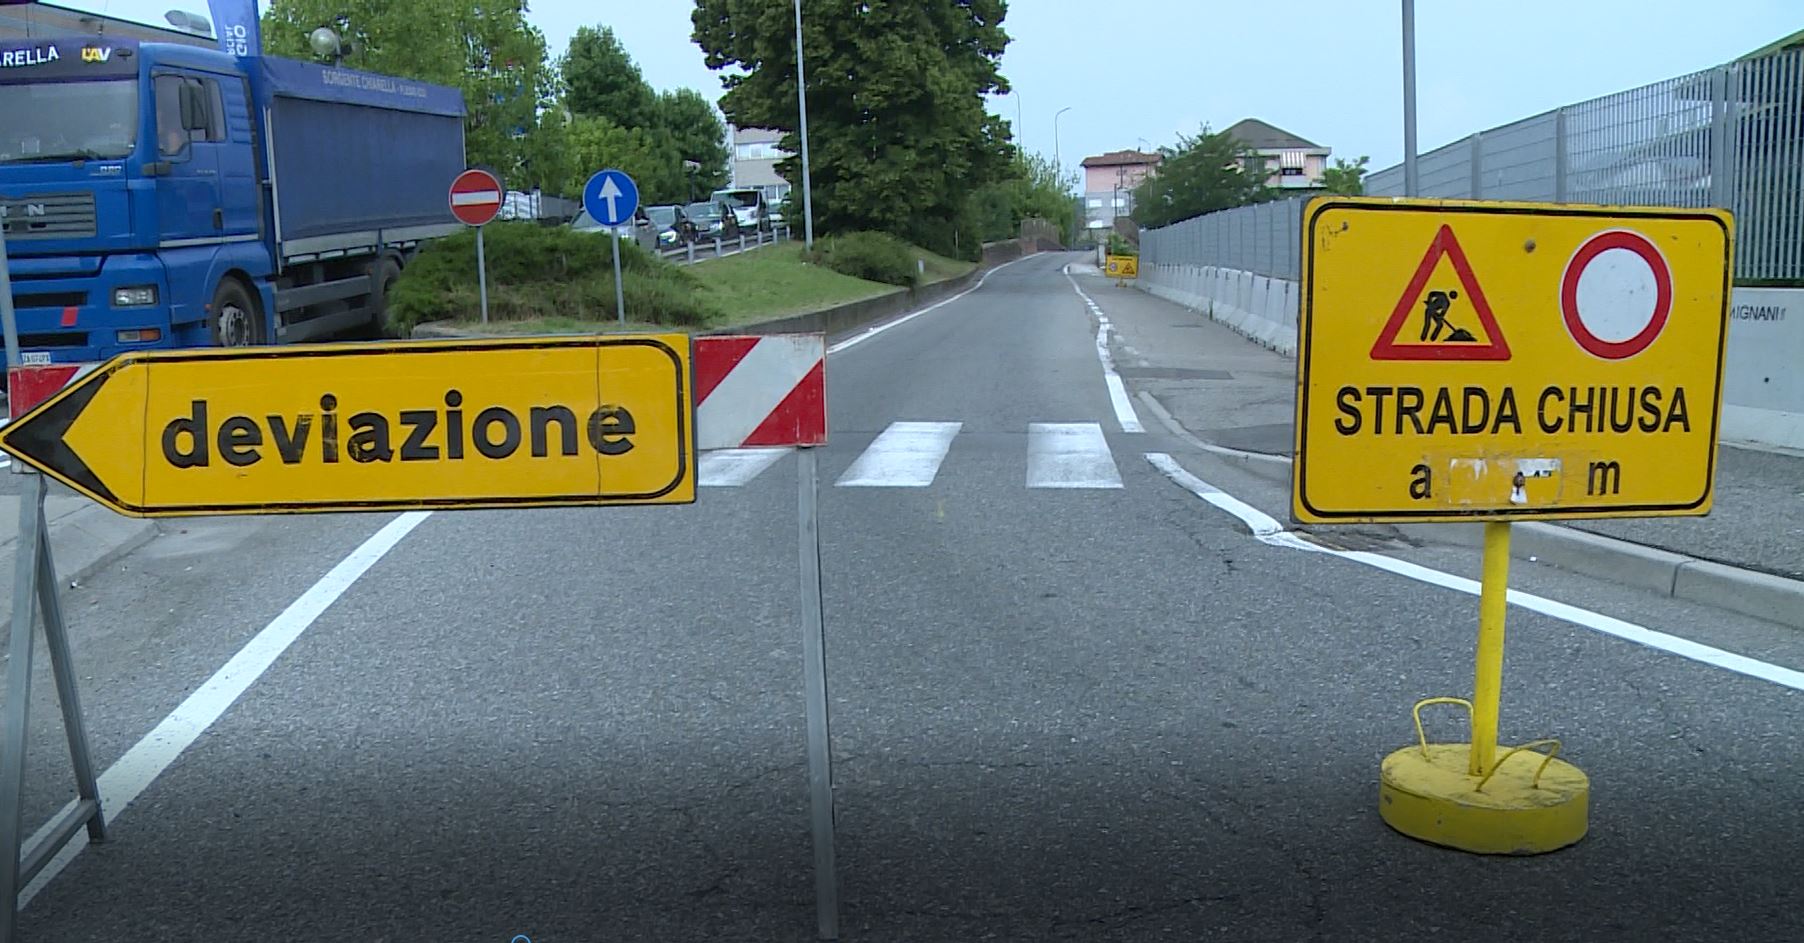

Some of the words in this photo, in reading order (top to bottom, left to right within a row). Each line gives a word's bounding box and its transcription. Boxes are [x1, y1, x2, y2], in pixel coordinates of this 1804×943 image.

[0, 46, 59, 66] RELLA
[161, 389, 637, 469] deviazione
[1334, 386, 1523, 436] STRADA
[1536, 386, 1692, 434] CHIUSA
[1409, 462, 1432, 500] a
[1587, 459, 1621, 497] m
